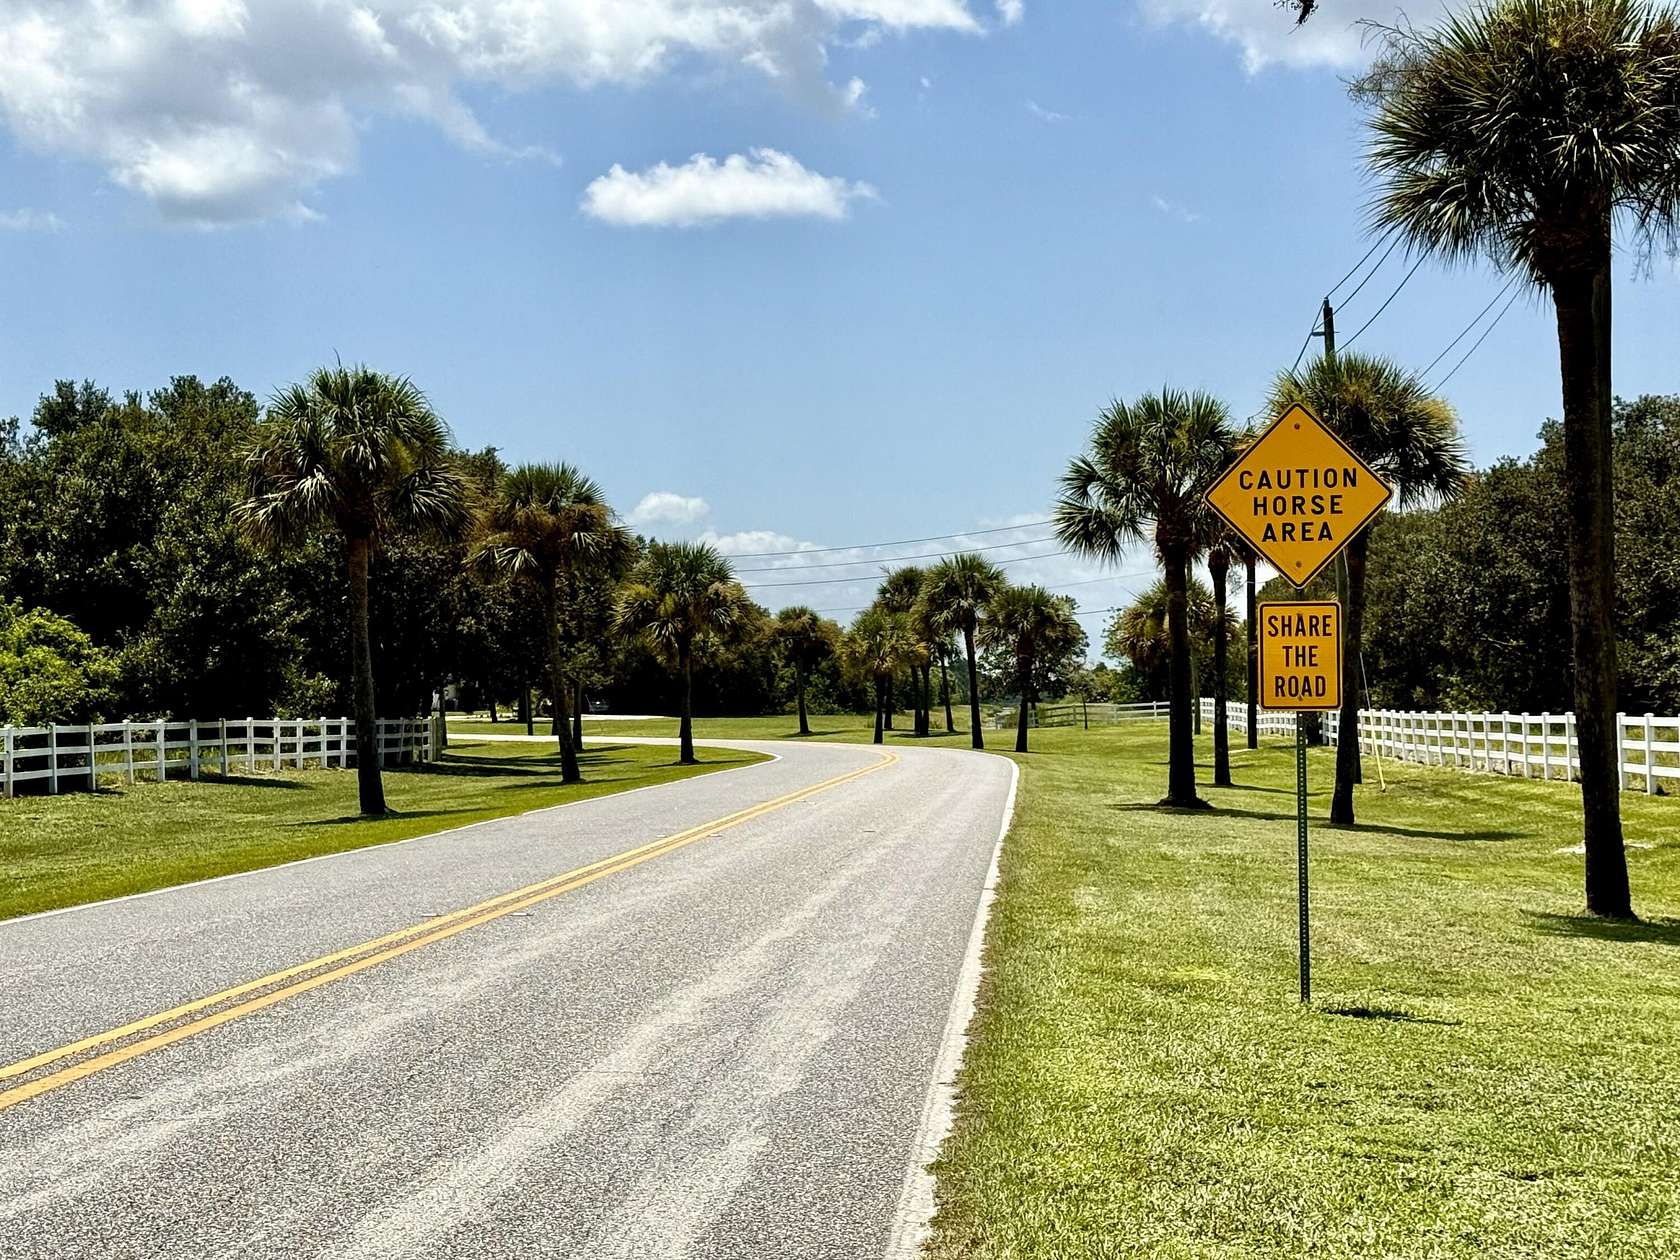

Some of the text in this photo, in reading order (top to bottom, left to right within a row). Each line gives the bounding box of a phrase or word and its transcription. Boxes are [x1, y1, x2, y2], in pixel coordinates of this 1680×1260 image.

[1239, 467, 1357, 490] CAUTION
[1253, 494, 1343, 516] HORSE
[1261, 521, 1333, 543] AREA
[1267, 614, 1332, 637] SHARE
[1282, 645, 1318, 667] THE
[1274, 675, 1326, 698] ROAD
